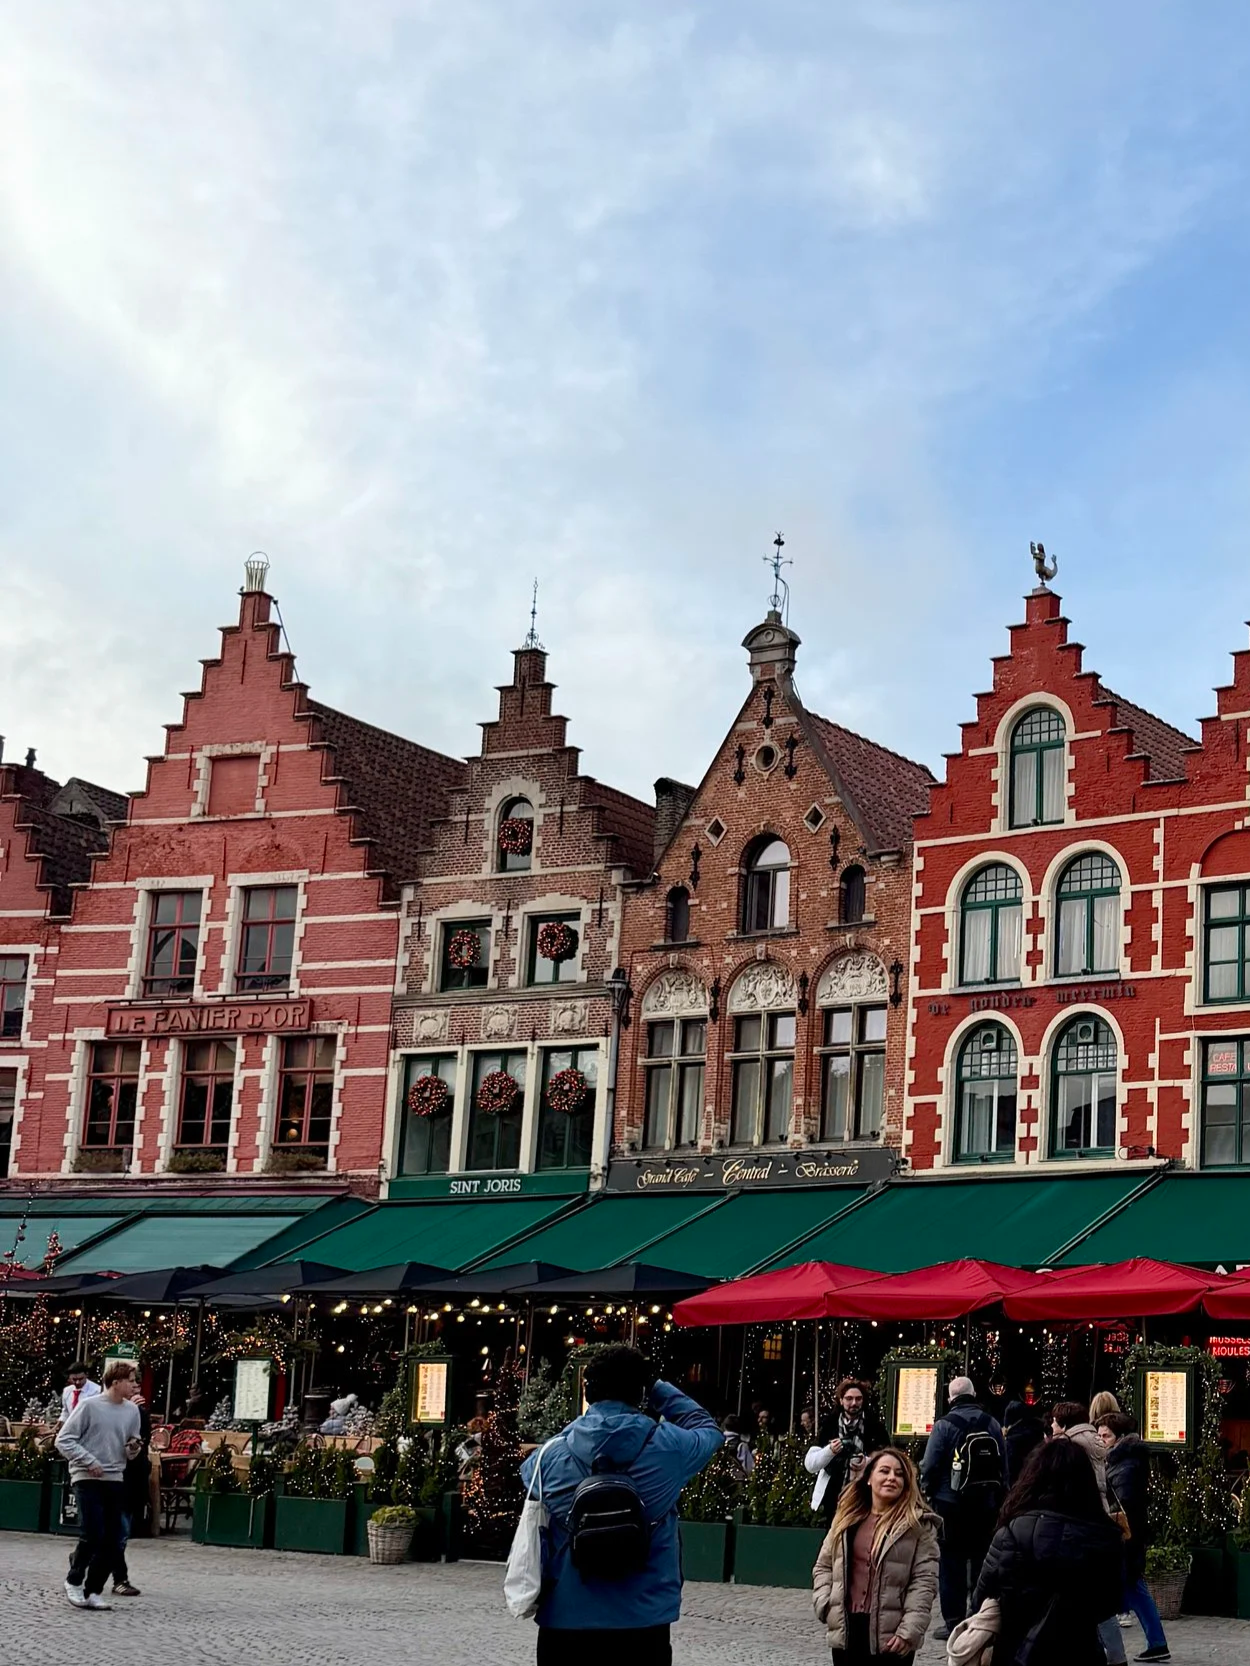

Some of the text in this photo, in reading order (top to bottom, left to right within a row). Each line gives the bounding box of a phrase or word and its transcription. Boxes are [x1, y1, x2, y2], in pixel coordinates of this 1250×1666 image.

[113, 1004, 306, 1034] LE PANIER D'OR
[721, 1158, 774, 1186] Central
[794, 1159, 860, 1179] Brasserie
[450, 1179, 521, 1194] SINT JORIS
[1211, 1346, 1250, 1357] MOULES
